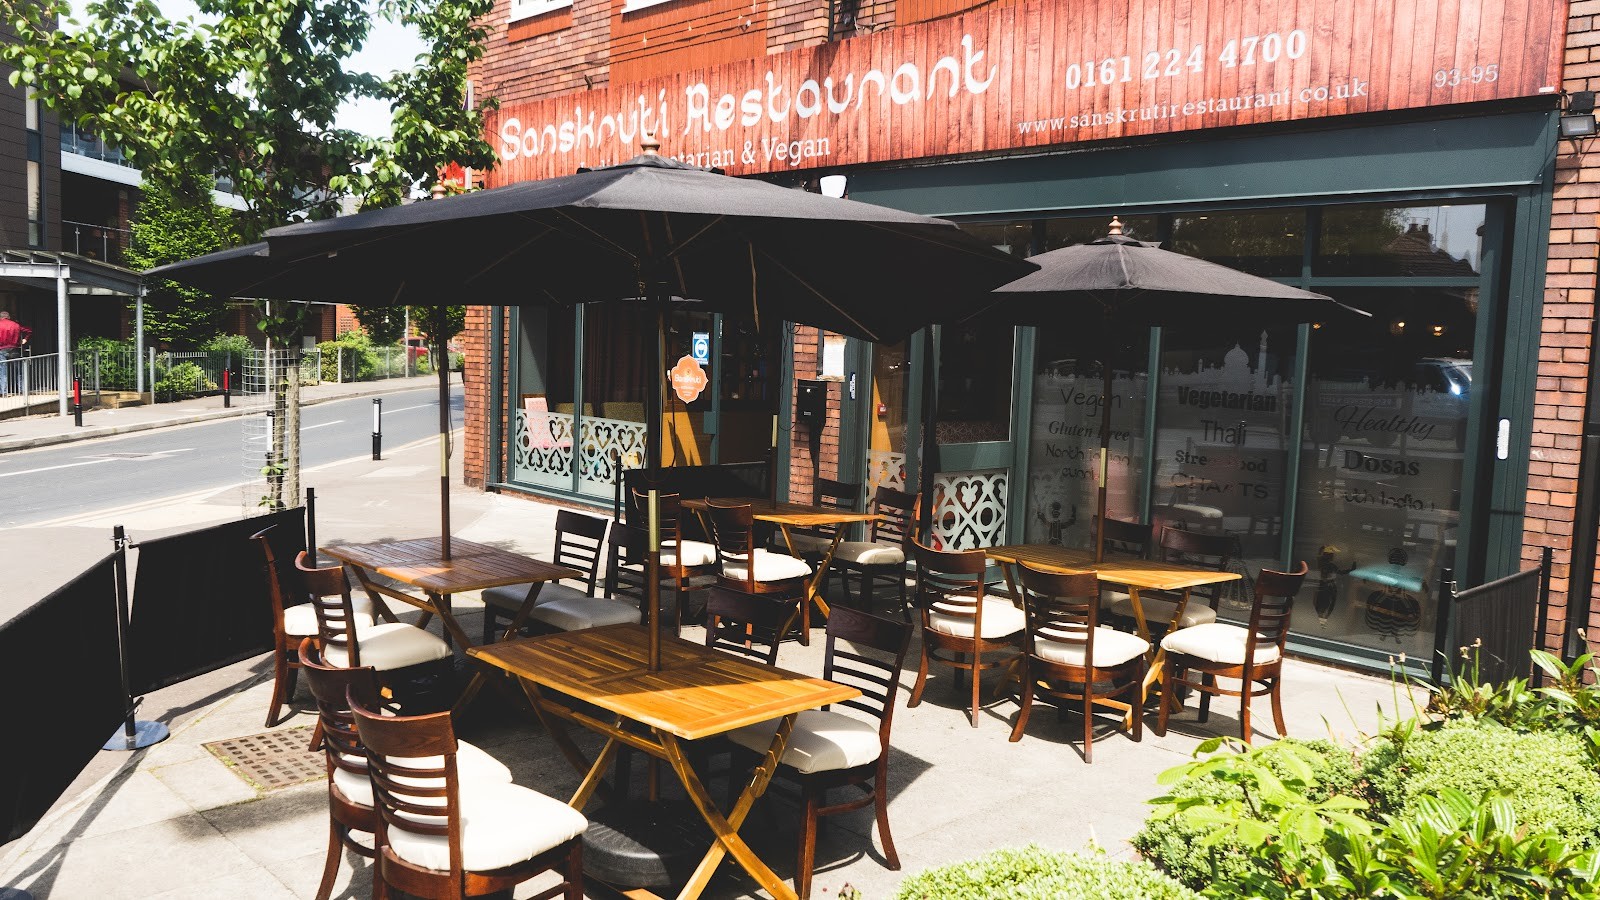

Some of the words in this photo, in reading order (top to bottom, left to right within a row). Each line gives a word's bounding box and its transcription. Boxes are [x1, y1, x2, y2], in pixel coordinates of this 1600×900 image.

[1065, 55, 1132, 90] 0161
[1144, 44, 1204, 79] 224
[1218, 29, 1307, 69] 4700
[1434, 64, 1499, 88] 93-95
[501, 88, 669, 161] Sanskruti
[683, 33, 997, 135] Restaurant
[1018, 78, 1367, 134] www.sanskrutirestaurant.co.uk
[671, 145, 735, 168] tarian
[741, 140, 756, 165] &
[761, 137, 831, 167] Vegan
[1178, 386, 1277, 412] Vegetarian
[1048, 421, 1093, 438] Gluten
[1098, 430, 1130, 441] ree
[1201, 419, 1247, 446] Thali
[1334, 405, 1436, 441] Healthy
[1045, 443, 1085, 460] North
[1089, 449, 1130, 466] Inian
[1175, 450, 1207, 466] Stre
[1342, 450, 1420, 476] Dosas
[1381, 490, 1436, 512] India
